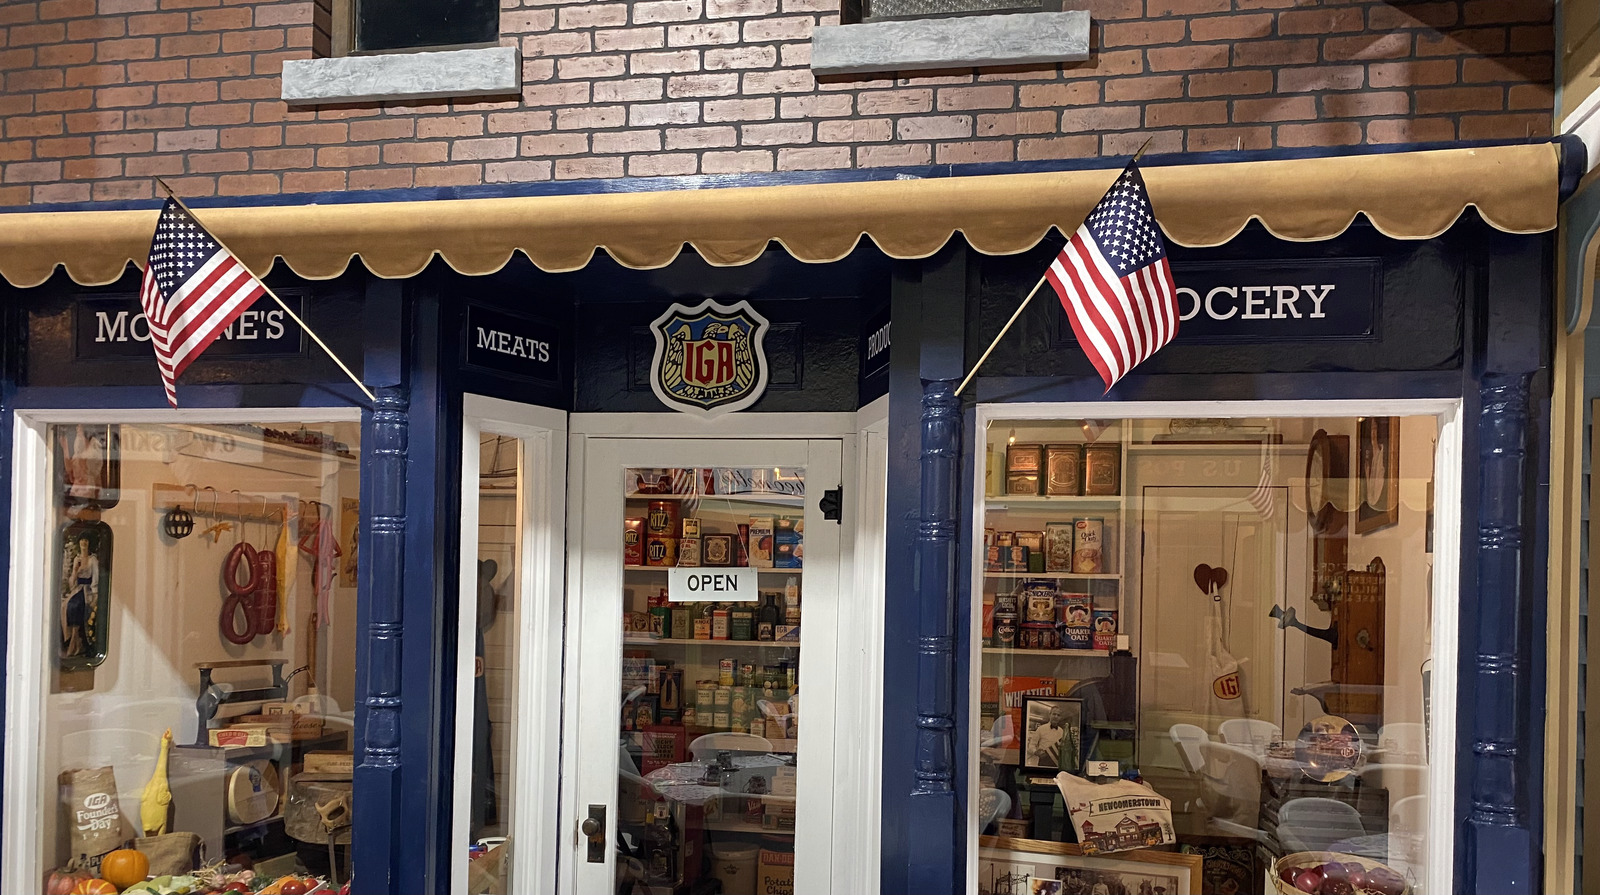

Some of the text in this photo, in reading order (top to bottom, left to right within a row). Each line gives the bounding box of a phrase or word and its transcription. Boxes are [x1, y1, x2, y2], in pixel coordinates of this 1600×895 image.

[1175, 284, 1336, 321] OCERY
[476, 326, 550, 363] MEATS
[867, 320, 892, 361] PRODUC
[683, 340, 735, 384] IGA
[650, 512, 668, 527] RITZ
[625, 533, 638, 543] RITZ
[649, 544, 665, 558] RITZ
[687, 574, 738, 592] OPEN
[1065, 628, 1091, 636] QUAKER
[87, 794, 108, 807] IGA
[1098, 798, 1161, 813] NEWCOMERSTOWN
[76, 803, 119, 824] Founder's
[90, 818, 112, 831] Day
[763, 853, 794, 864] DAN-DE
